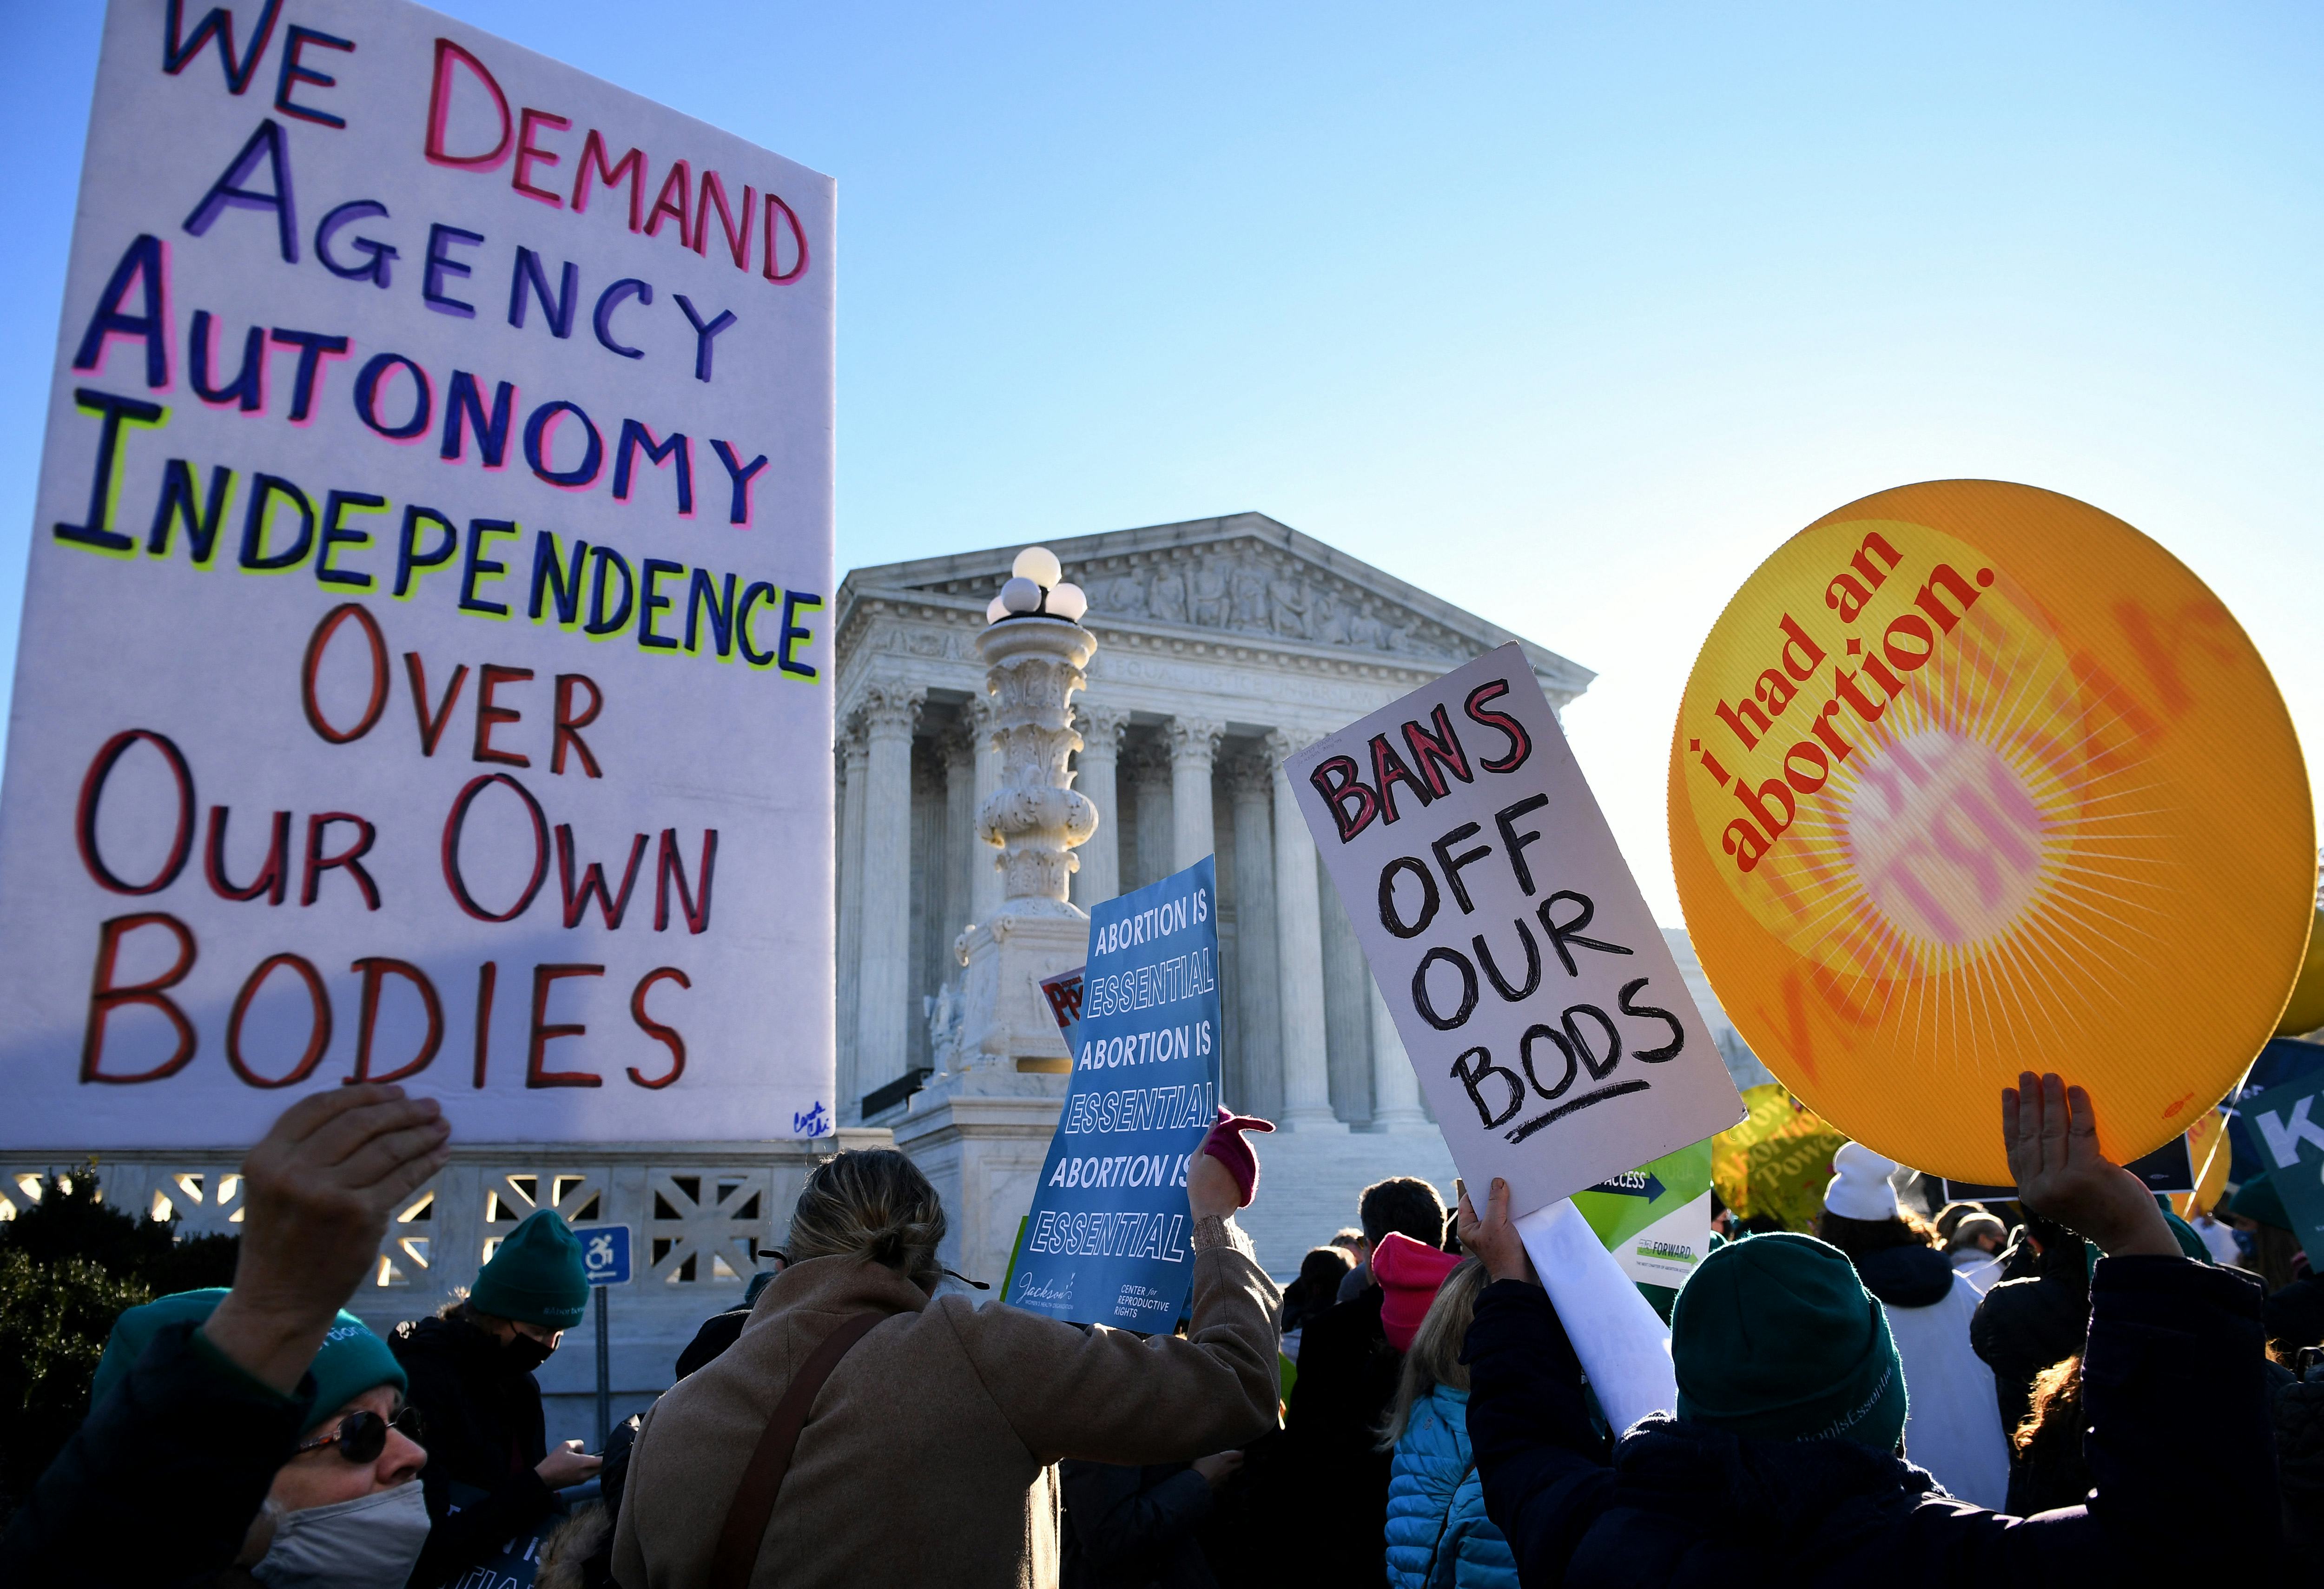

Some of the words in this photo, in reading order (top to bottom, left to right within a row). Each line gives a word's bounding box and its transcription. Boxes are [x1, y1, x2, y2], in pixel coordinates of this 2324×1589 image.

[163, 0, 356, 129] WE
[425, 37, 811, 286] DEMAND
[182, 118, 738, 383] AGENCY
[71, 233, 772, 530] AUTONOMY
[53, 387, 825, 685] INDEPENDENCE
[301, 602, 604, 778] OVER
[1689, 738, 1732, 789] i
[1714, 612, 1827, 752] had
[1825, 531, 1904, 625] an
[1722, 562, 1995, 873] abortion.
[75, 728, 382, 911] OUR
[441, 773, 718, 934] OWN
[1310, 679, 1532, 844] BANS
[1095, 896, 1187, 956] ABORTION
[1193, 888, 1208, 925] IS
[1378, 793, 1549, 939] OFF
[79, 912, 691, 1089] BODIES
[1086, 947, 1214, 1019] ESSENTIAL
[1412, 890, 1634, 1031] OUR
[1064, 1081, 1218, 1134] ESSENTIAL
[1078, 1025, 1188, 1071] ABORTION
[1196, 1020, 1211, 1056] IS
[1451, 977, 1684, 1130] BODS
[1048, 1154, 1169, 1188] ABORTION
[1715, 1113, 1818, 1185] Abortio
[1029, 1210, 1185, 1263] ESSENTIAL
[1117, 1295, 1170, 1312] REPRODUCTIVE
[1121, 1284, 1146, 1296] CENTER
[1146, 1287, 1157, 1297] for
[1114, 1306, 1137, 1318] RIGHTS
